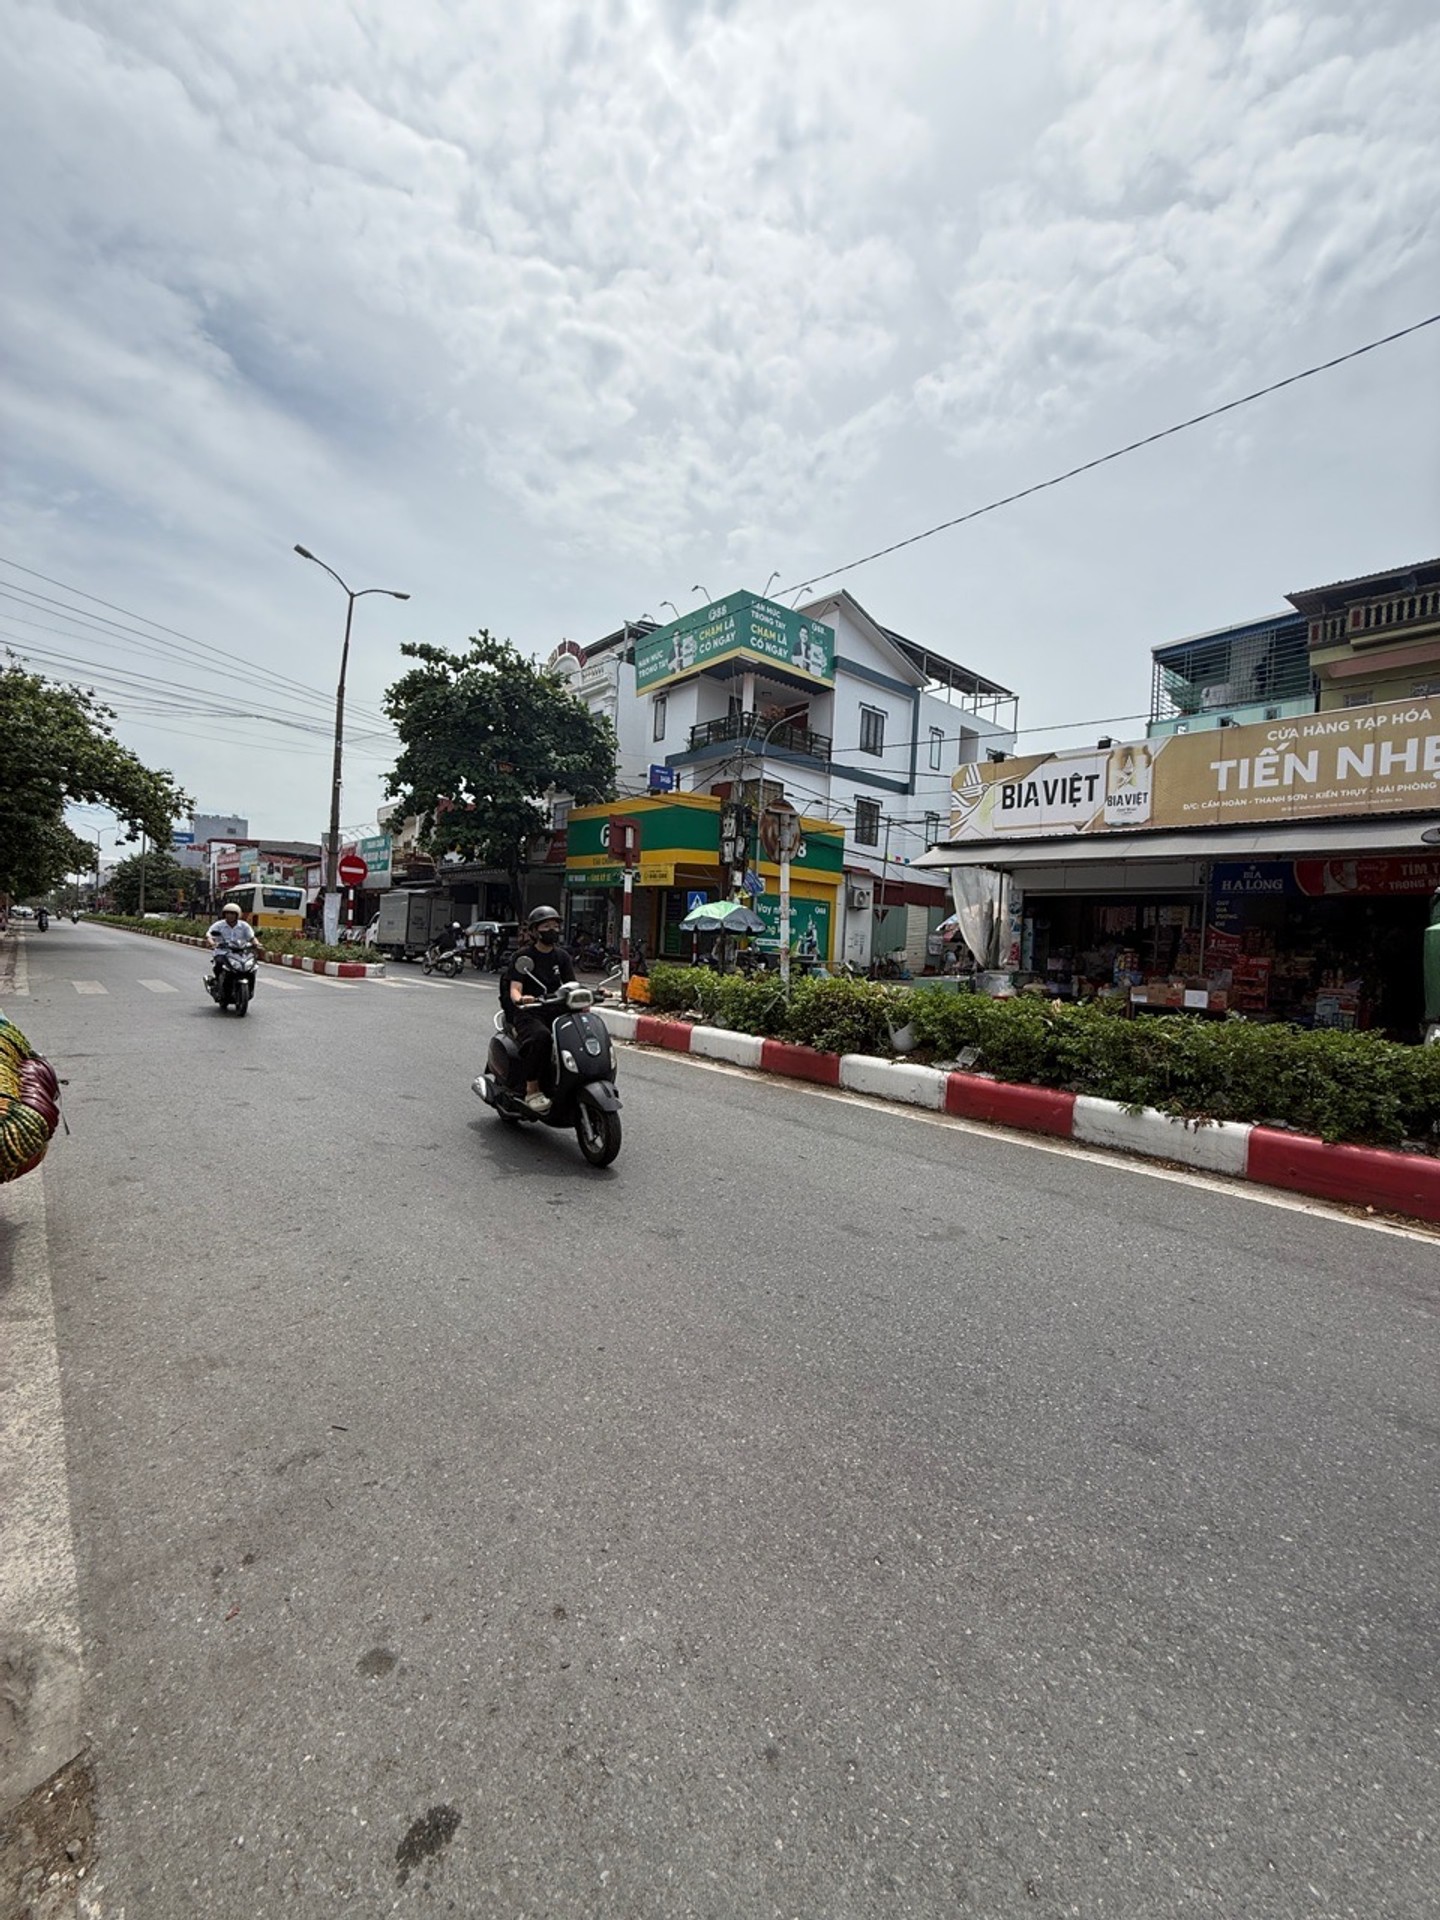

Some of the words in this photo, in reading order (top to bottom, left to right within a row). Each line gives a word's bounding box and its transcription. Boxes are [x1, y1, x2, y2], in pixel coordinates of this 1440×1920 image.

[713, 630, 737, 649] NGAY
[765, 642, 788, 658] NGAY
[1267, 726, 1299, 741] CỬA
[1303, 720, 1350, 737] HÀNG
[1354, 715, 1387, 731] TẠP
[1392, 708, 1433, 725] HÓA
[1210, 742, 1319, 792] TIẾN
[1002, 781, 1040, 810] BIA
[1042, 772, 1100, 808] VIỆT
[1107, 795, 1124, 807] BIA
[1124, 791, 1149, 806] VIỆT
[1254, 796, 1285, 805] THANH
[1287, 792, 1308, 802] SƠN
[1396, 781, 1437, 792] PHÒNG
[1243, 871, 1262, 879] BIA
[757, 903, 771, 915] Vay
